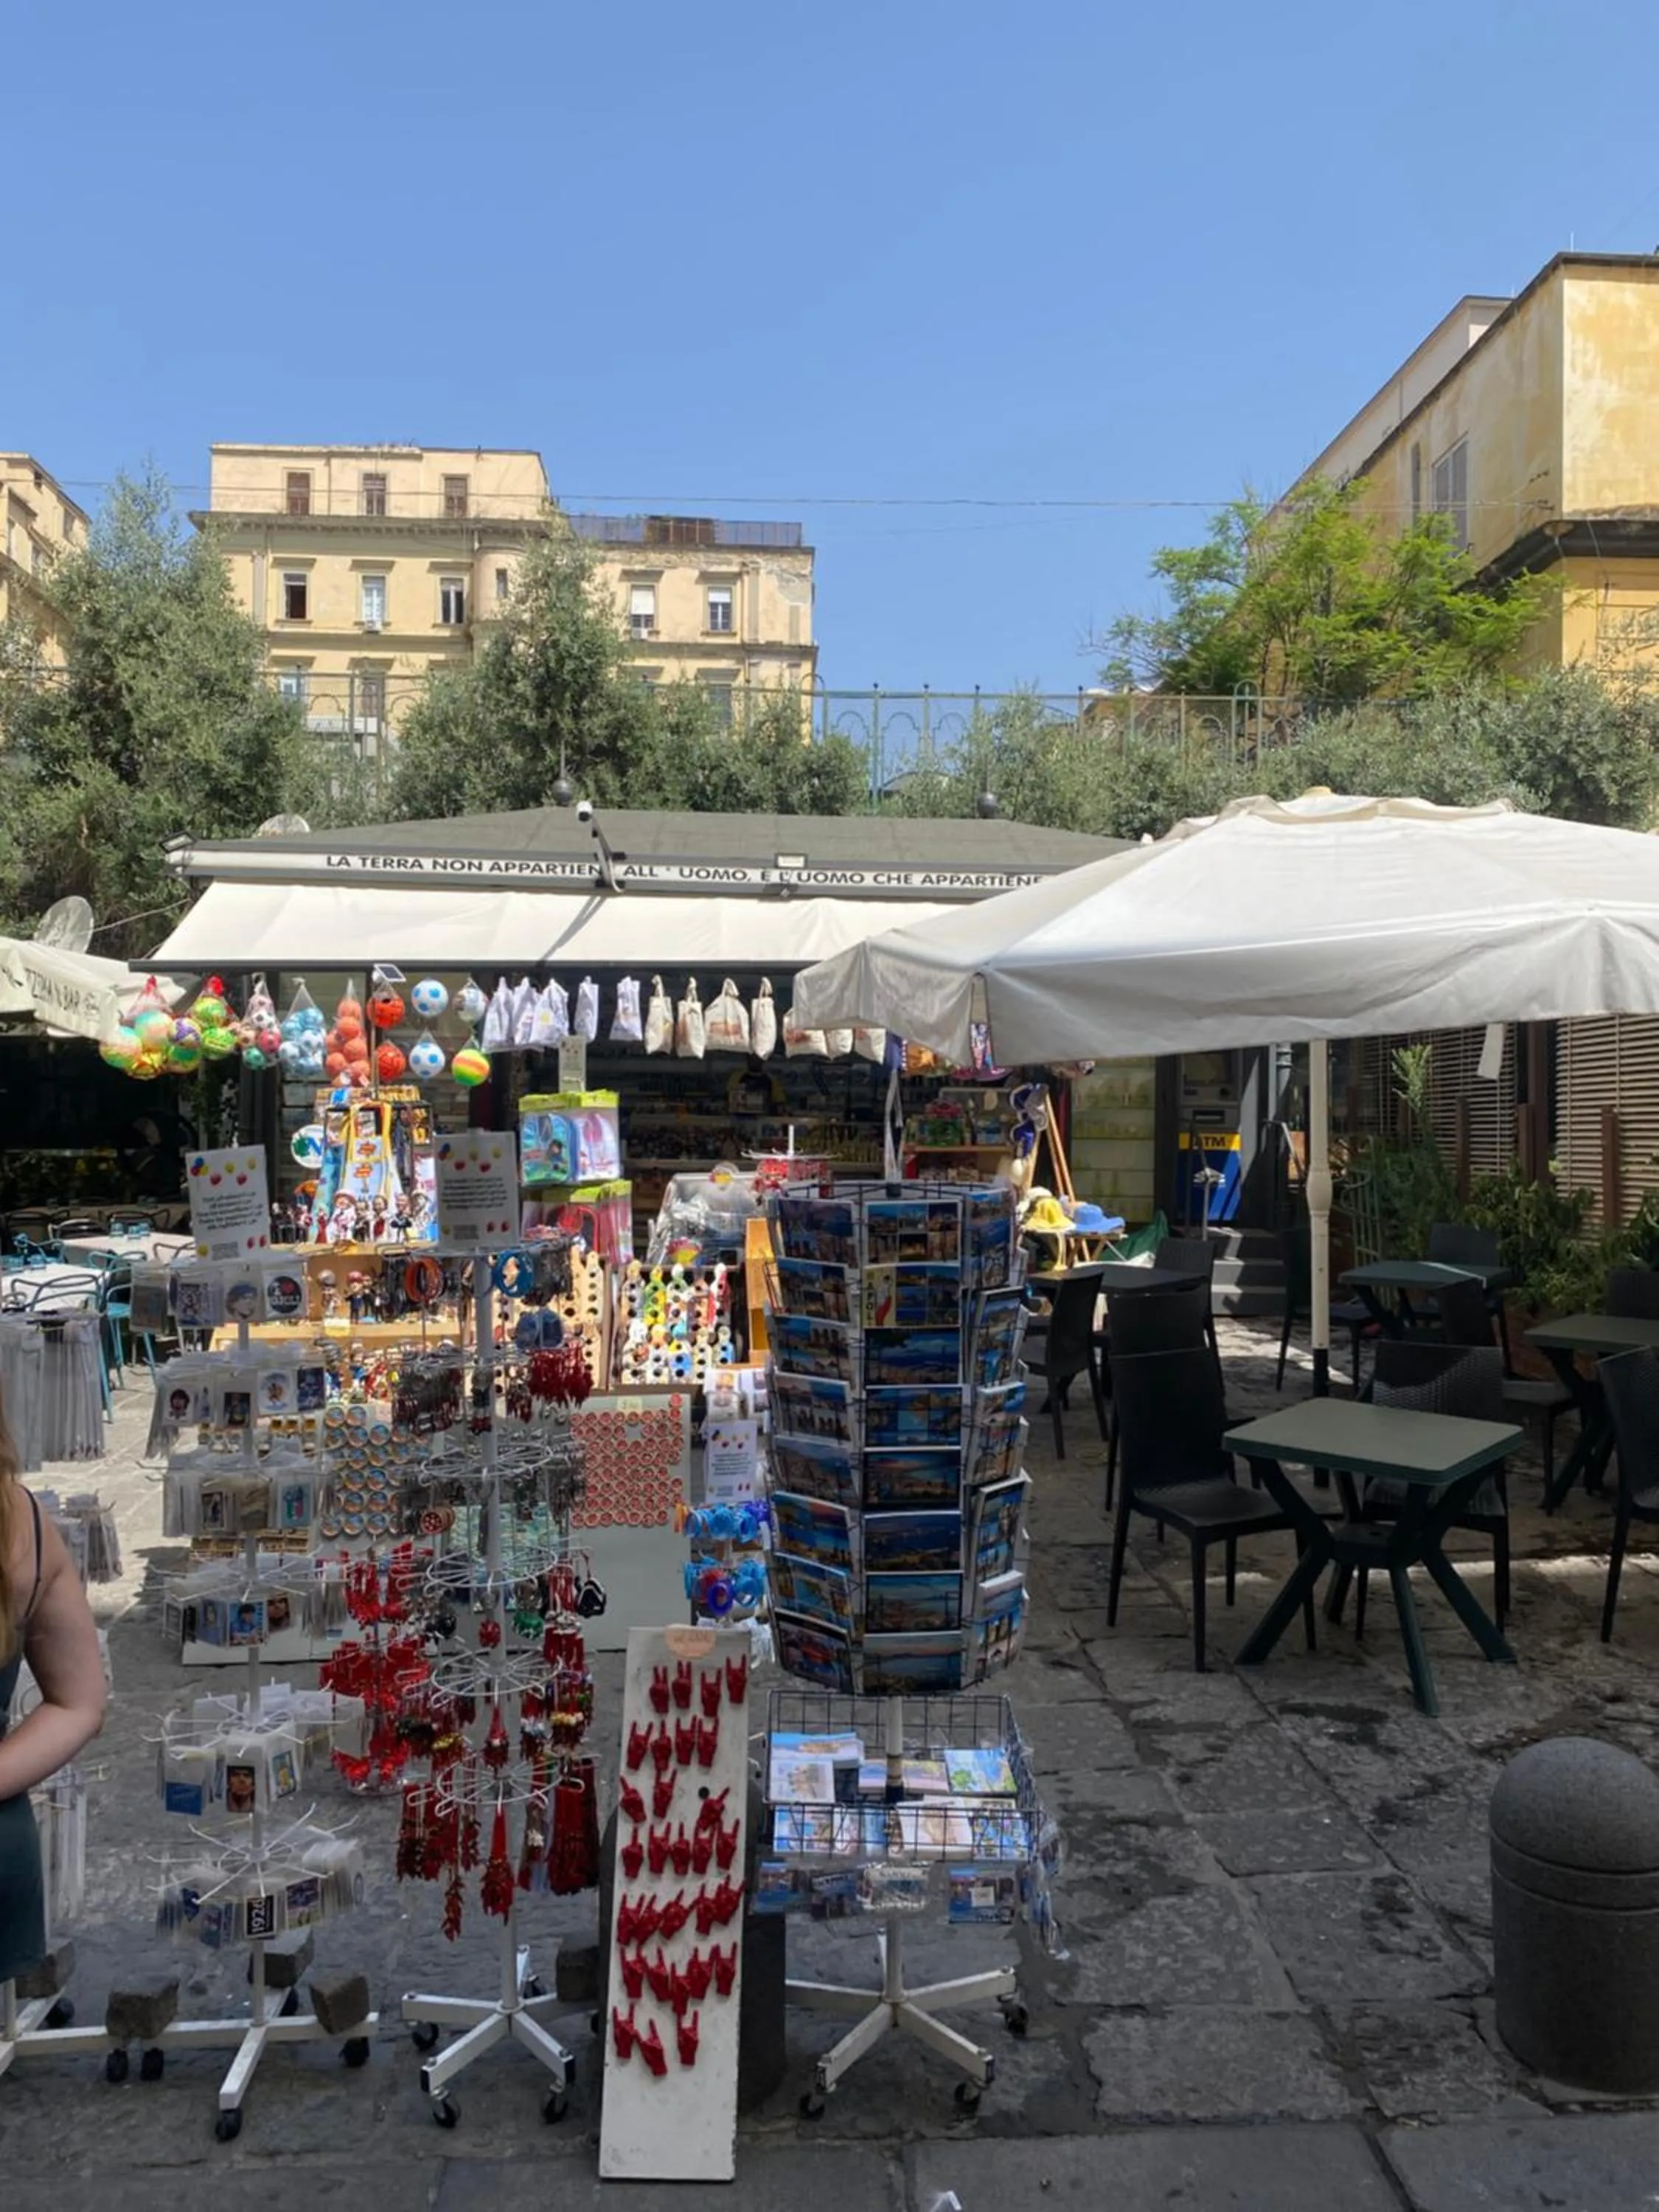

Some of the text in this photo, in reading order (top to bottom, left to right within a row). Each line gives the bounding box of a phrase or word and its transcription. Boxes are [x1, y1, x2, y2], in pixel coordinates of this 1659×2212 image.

[326, 855, 351, 868] LA
[359, 856, 424, 870] TERRA
[432, 858, 482, 872] NON
[489, 860, 604, 876] APPARTIEN
[872, 873, 914, 885] CHE
[1194, 1136, 1226, 1148] TM
